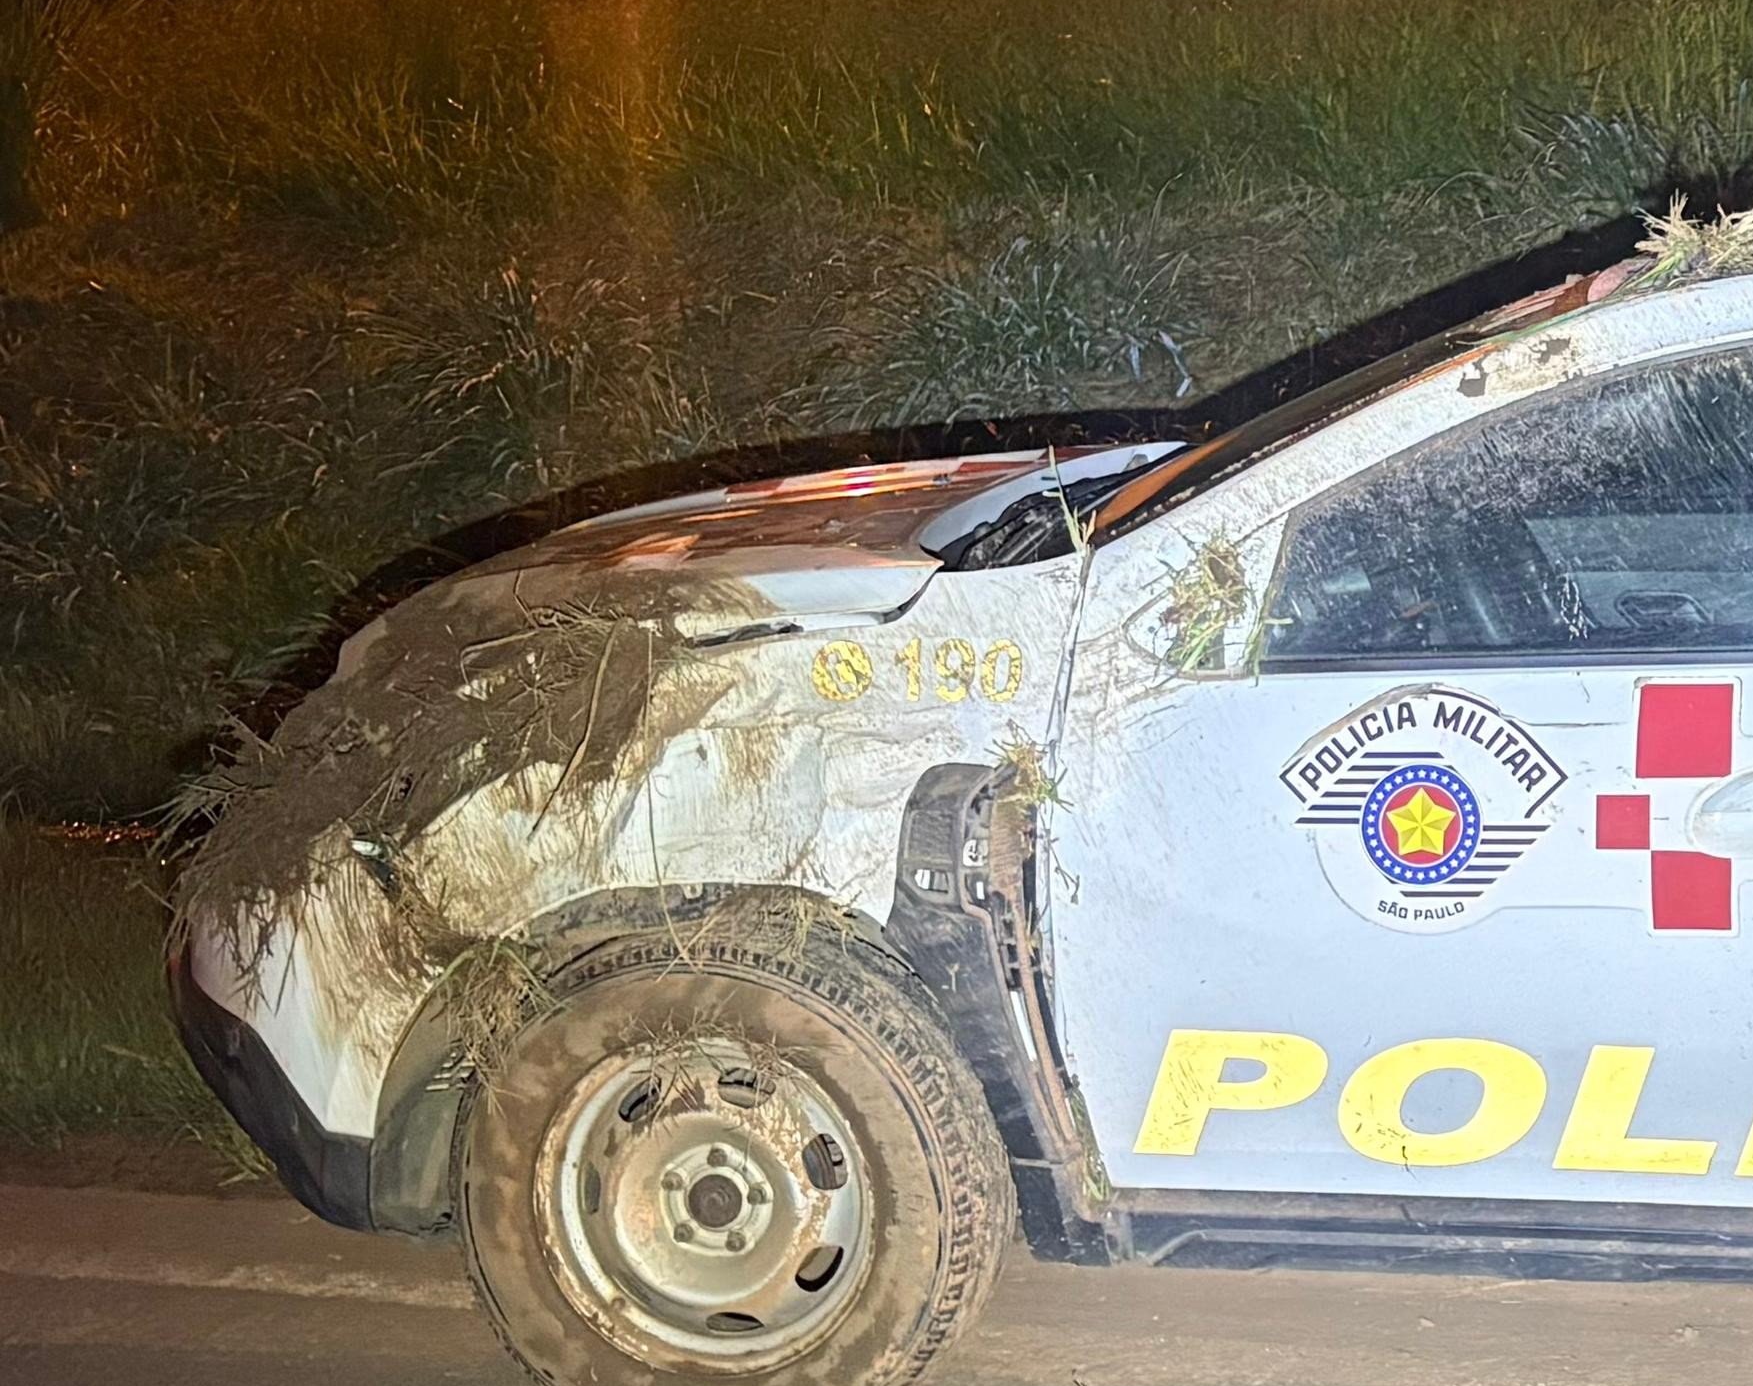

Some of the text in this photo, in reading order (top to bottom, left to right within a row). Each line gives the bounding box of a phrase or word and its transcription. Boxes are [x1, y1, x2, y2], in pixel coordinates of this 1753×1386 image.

[894, 636, 1024, 703] 190
[1298, 700, 1548, 793] POLICIA MILITAR
[1377, 899, 1465, 921] SÃO PAULO
